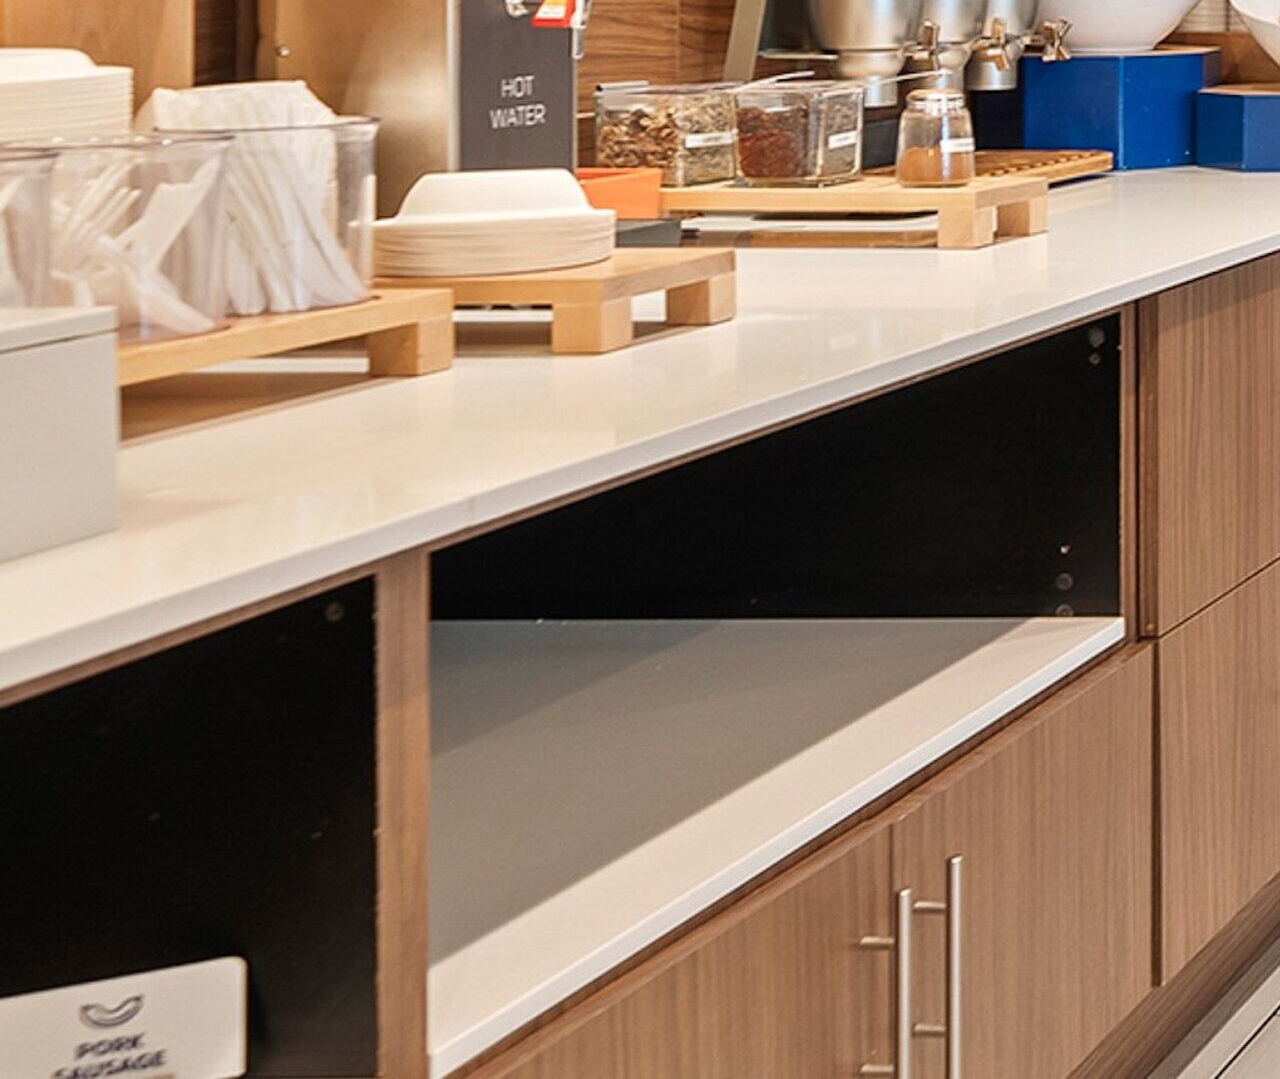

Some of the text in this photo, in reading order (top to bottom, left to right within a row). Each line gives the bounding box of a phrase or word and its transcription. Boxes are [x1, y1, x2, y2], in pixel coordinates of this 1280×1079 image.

[501, 75, 535, 97] HOT
[489, 103, 546, 129] WATER
[76, 1032, 146, 1060] PORK
